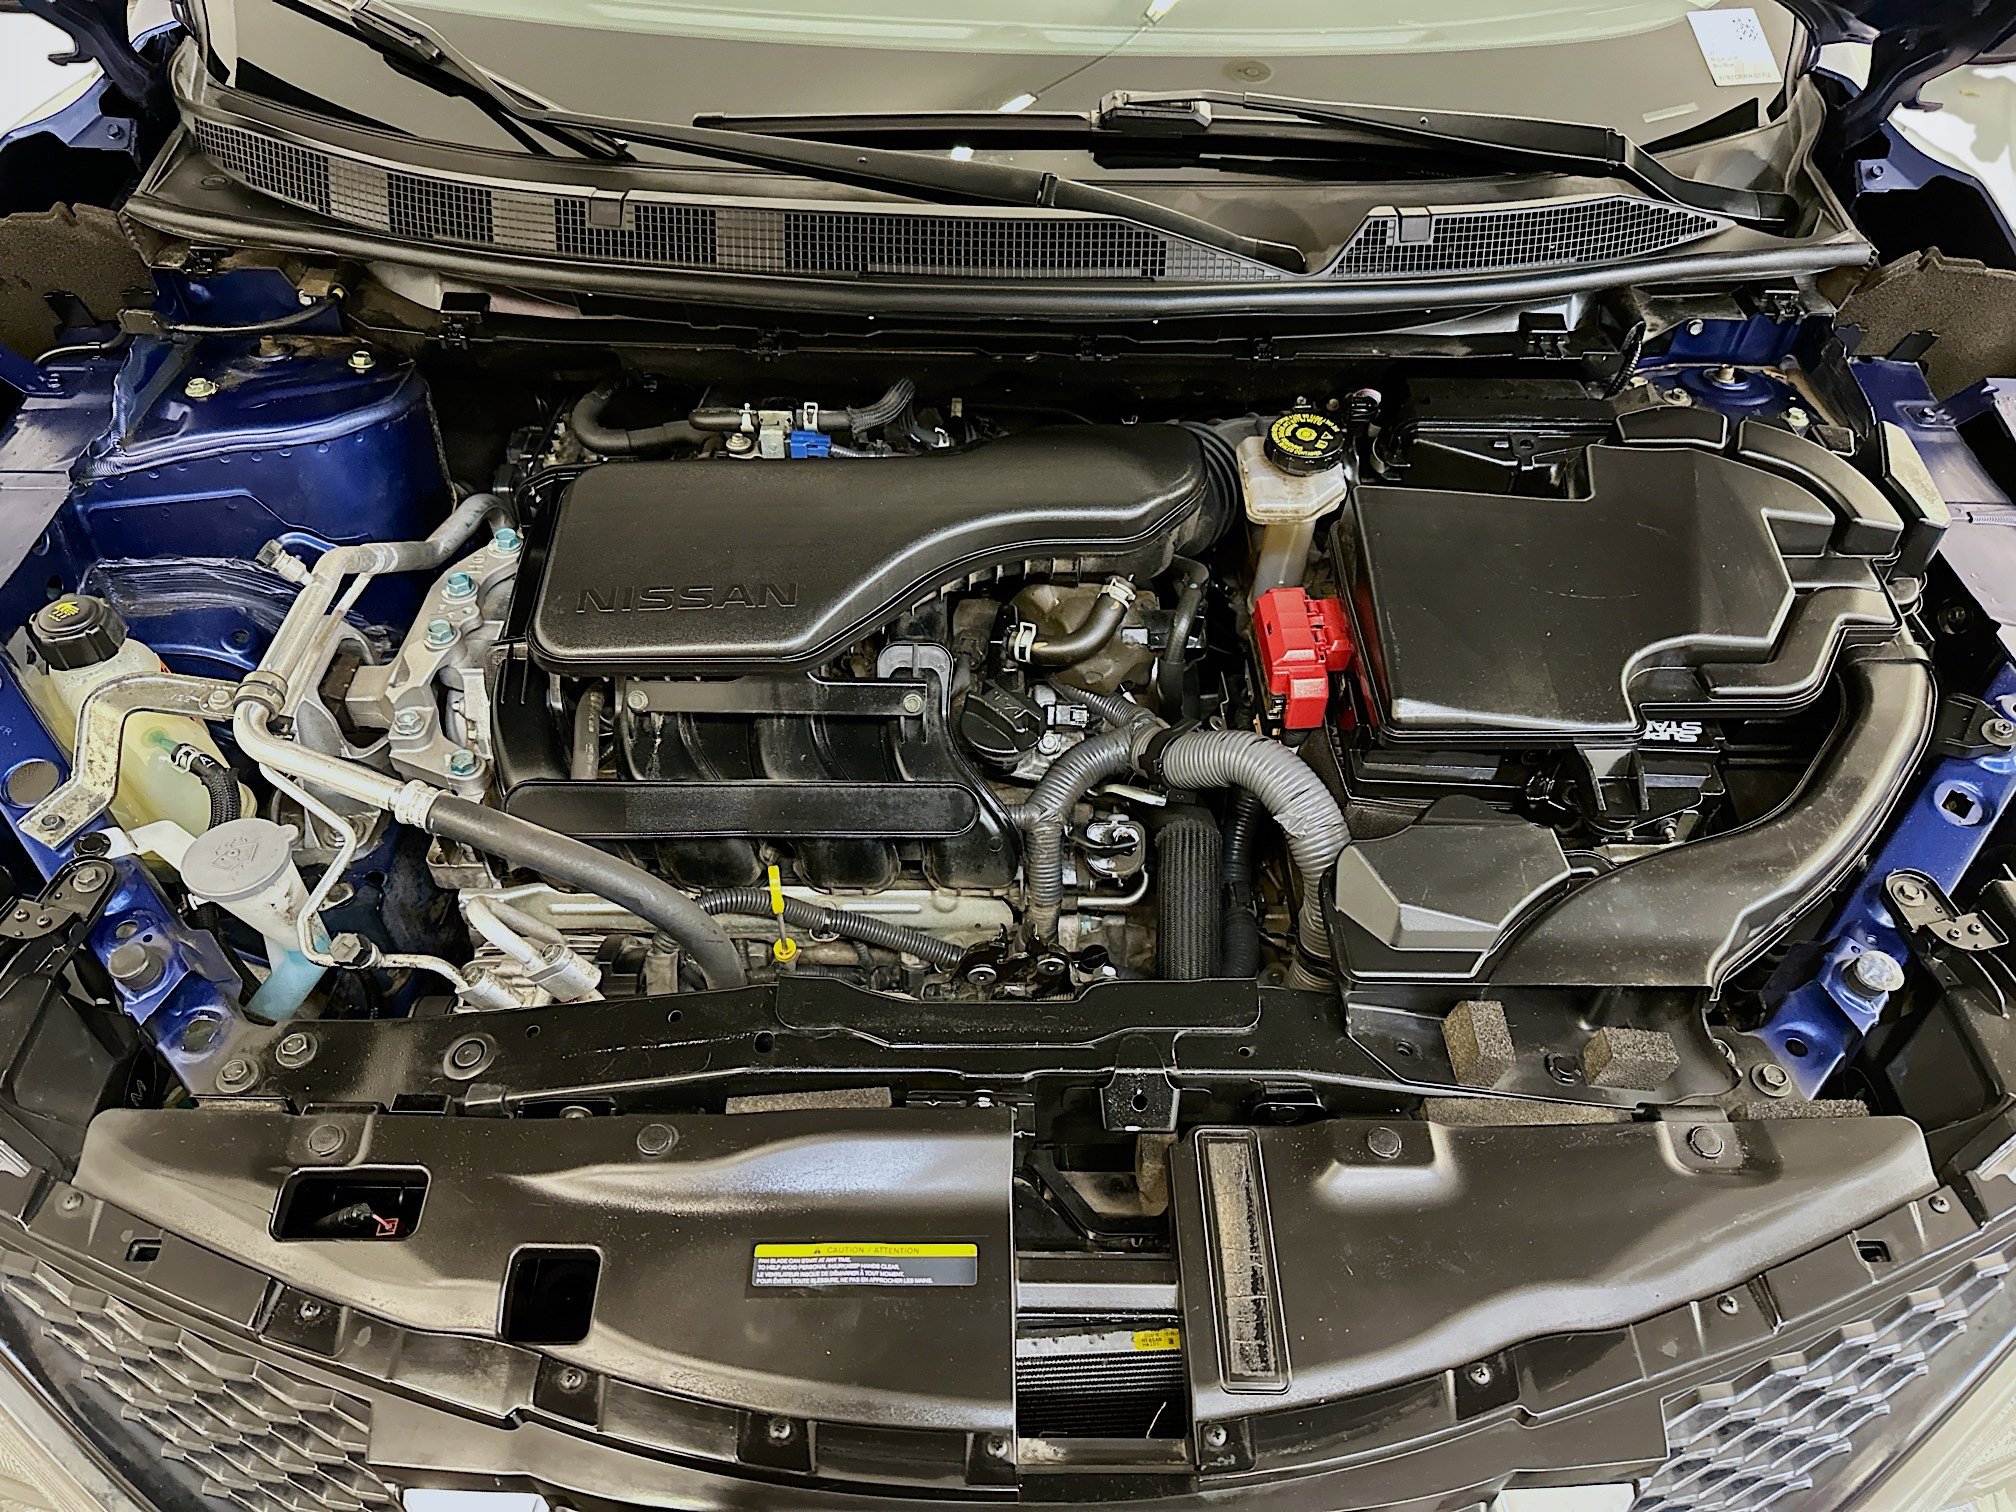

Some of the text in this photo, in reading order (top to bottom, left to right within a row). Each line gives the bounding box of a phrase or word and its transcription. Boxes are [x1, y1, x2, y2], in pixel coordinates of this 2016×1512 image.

[575, 582, 799, 614] NISSAN
[1646, 721, 1703, 735] STA
[1643, 731, 1698, 743] SUP
[826, 1246, 865, 1254] CAUTION
[873, 1247, 920, 1255] ATTENTION
